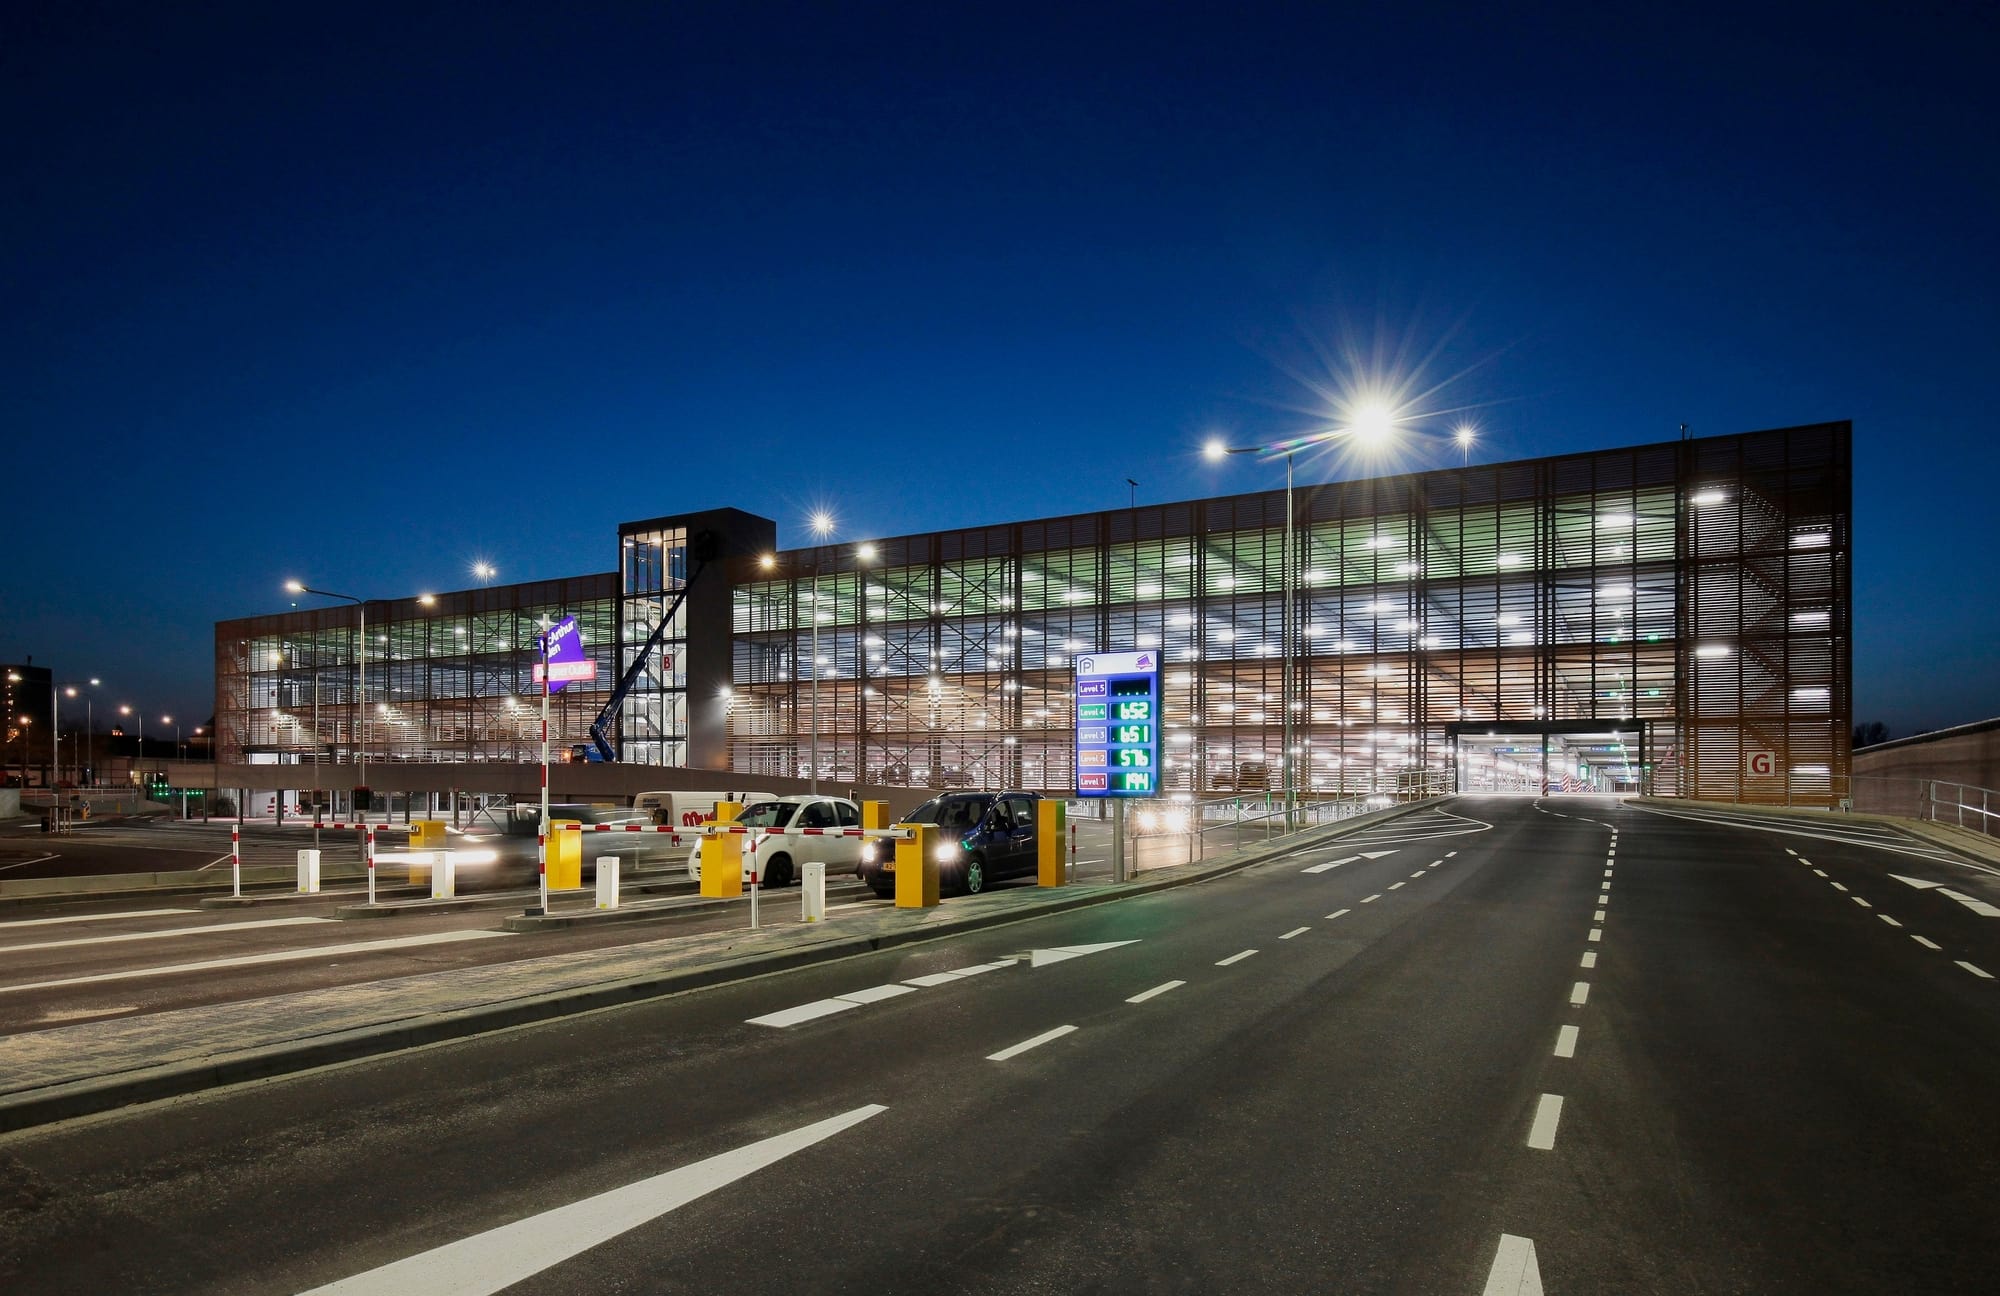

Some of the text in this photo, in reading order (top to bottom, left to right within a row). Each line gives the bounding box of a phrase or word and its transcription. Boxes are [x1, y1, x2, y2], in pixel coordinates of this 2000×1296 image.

[664, 656, 671, 669] B
[1080, 684, 1098, 693] Level
[1080, 707, 1098, 716] Level
[1121, 702, 1148, 720] 652
[1080, 731, 1098, 740] Level
[1121, 725, 1148, 743] 651
[1080, 754, 1098, 763] Level
[1121, 749, 1148, 767] 576
[1752, 754, 1770, 774] G
[1080, 777, 1098, 786] Level
